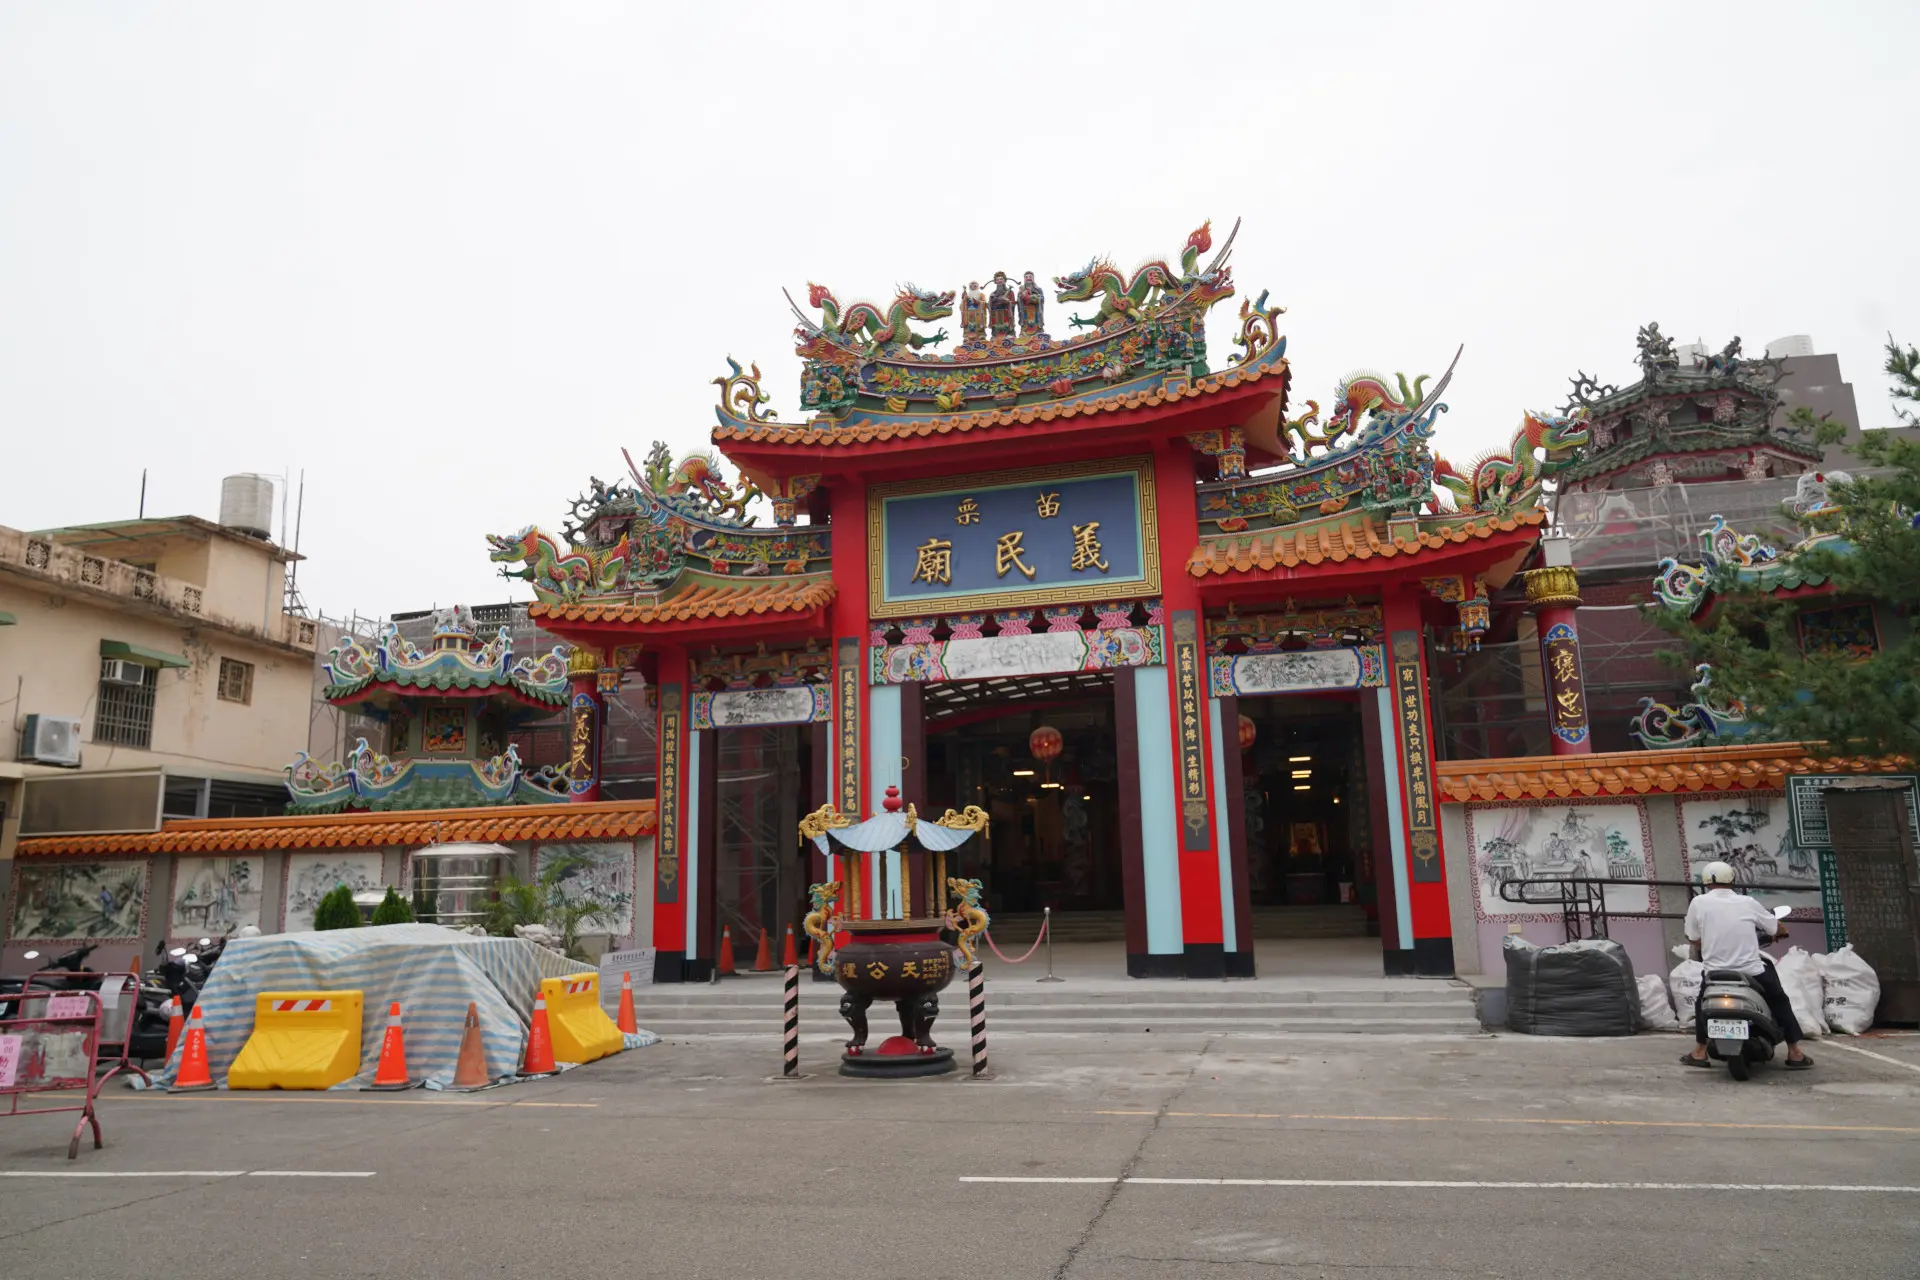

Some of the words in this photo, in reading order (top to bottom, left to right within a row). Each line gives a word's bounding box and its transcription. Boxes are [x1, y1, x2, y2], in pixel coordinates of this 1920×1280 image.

[954, 490, 1061, 526] 苗栗
[911, 521, 1109, 586] 義民廟
[1550, 648, 1583, 720] 褒忠
